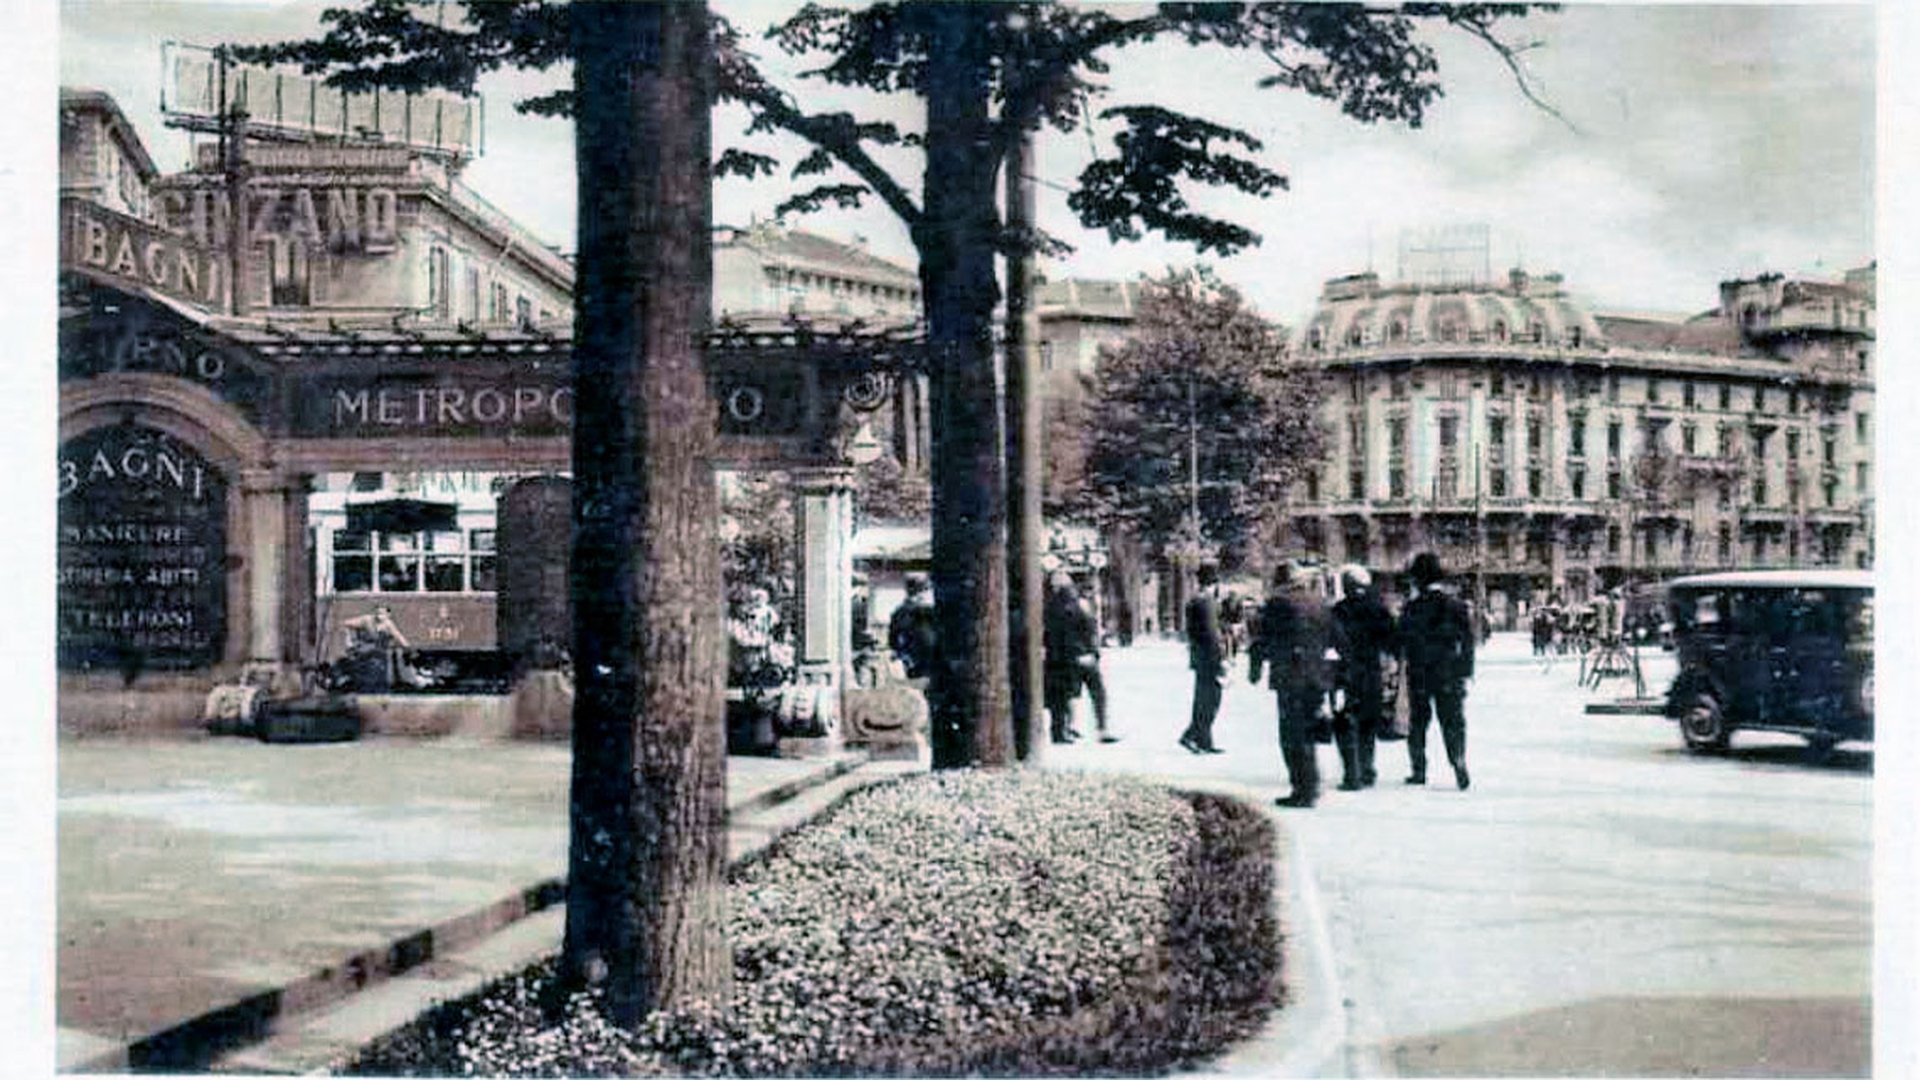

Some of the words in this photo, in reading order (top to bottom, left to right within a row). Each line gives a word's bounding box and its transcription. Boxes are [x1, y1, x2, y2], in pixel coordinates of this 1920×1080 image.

[153, 189, 397, 248] CINZANO
[83, 216, 219, 300] BAGNI
[60, 448, 203, 499] BAGNI
